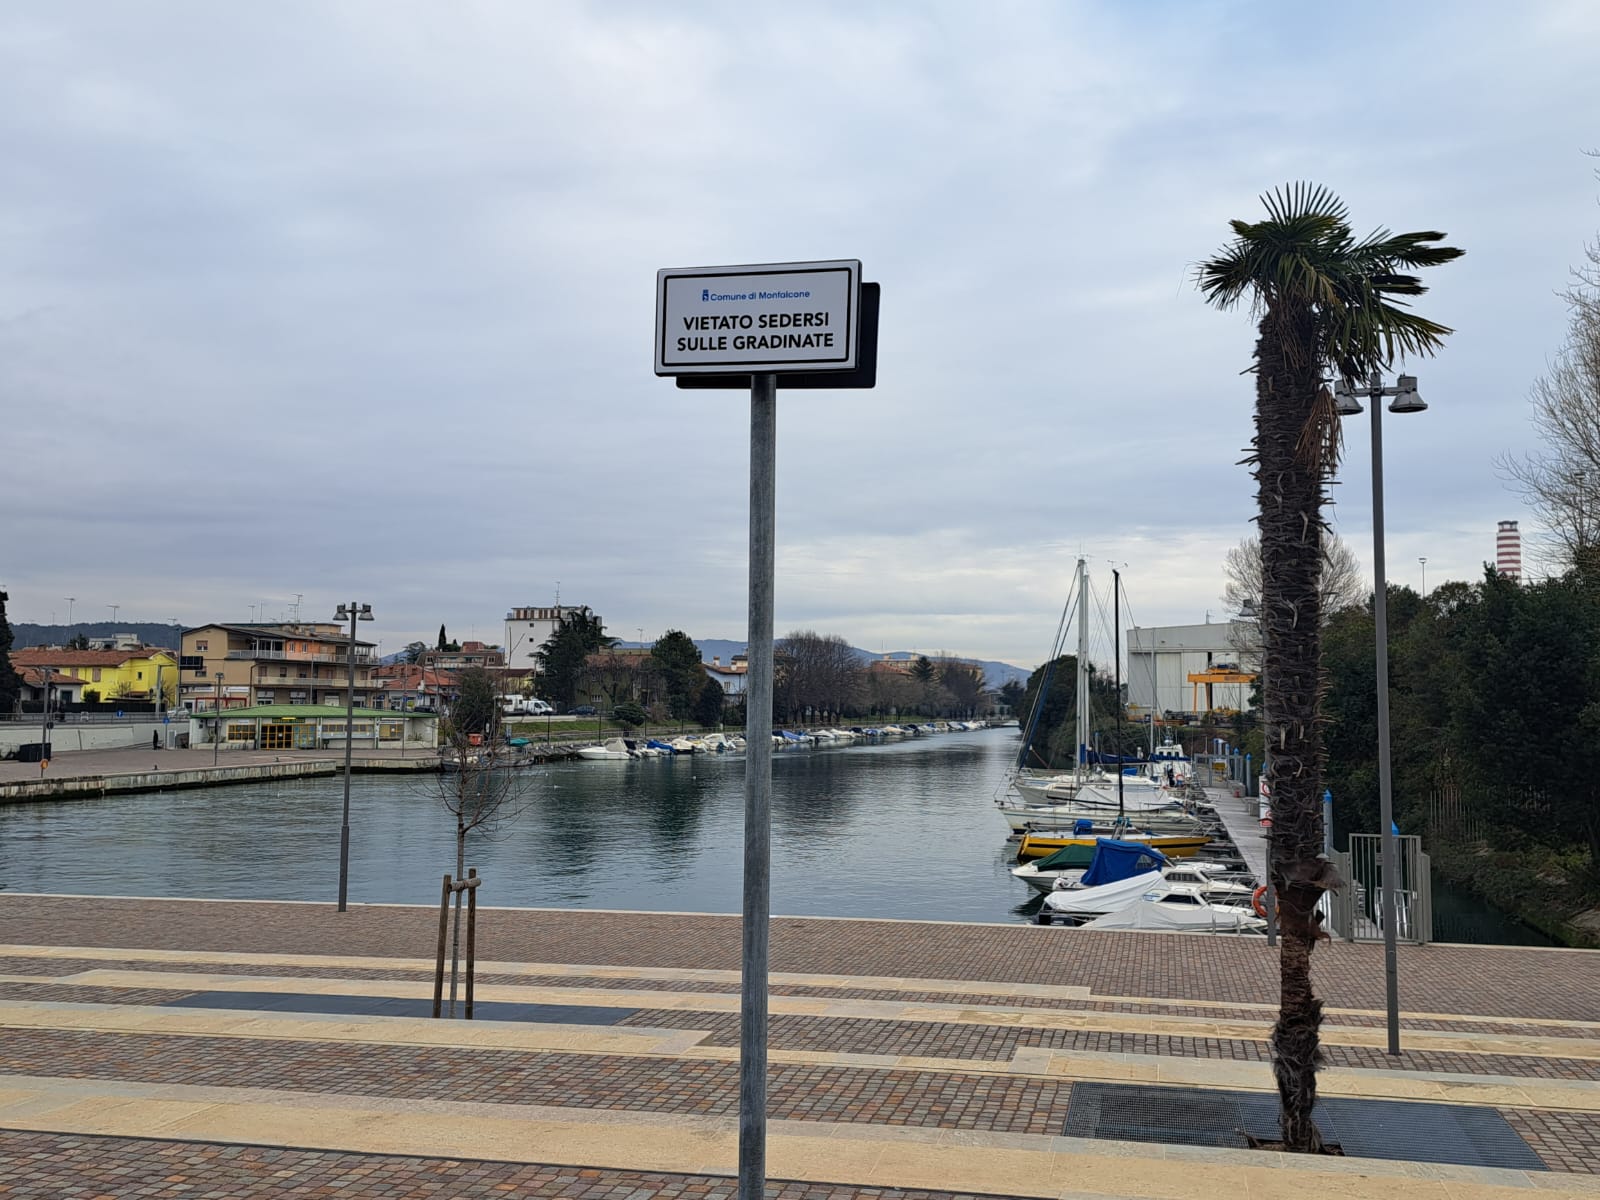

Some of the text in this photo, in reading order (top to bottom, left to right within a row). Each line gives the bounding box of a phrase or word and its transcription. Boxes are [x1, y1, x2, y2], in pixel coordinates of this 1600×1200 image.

[711, 289, 810, 302] Comune di Monfalcone
[683, 312, 829, 331] VIETATO SEDERSI
[677, 333, 834, 351] SULLE GRADINATE
